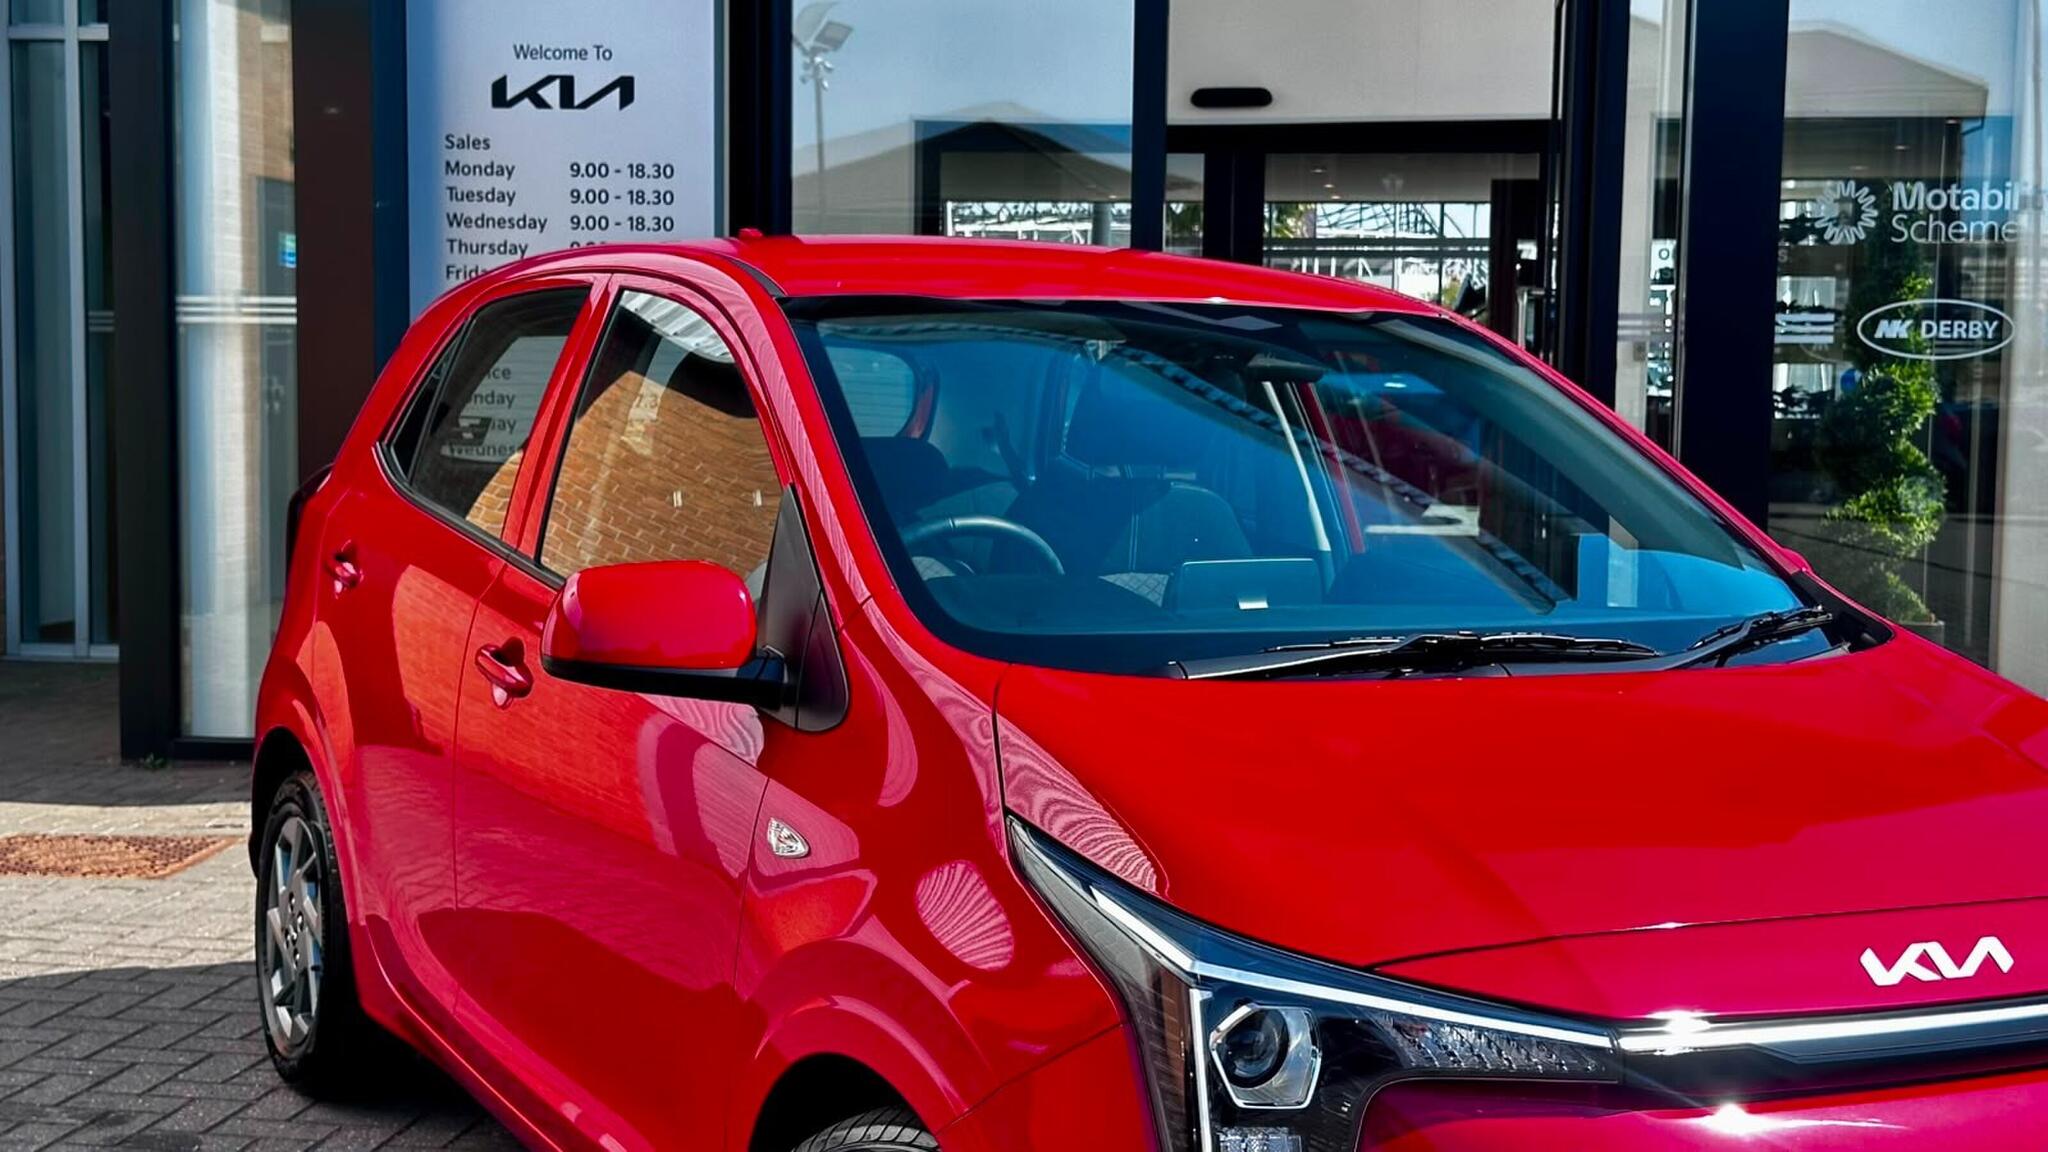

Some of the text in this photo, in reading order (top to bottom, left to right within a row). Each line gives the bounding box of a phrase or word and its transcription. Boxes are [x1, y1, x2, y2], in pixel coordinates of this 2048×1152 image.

[513, 44, 613, 60] Welcome To
[491, 74, 635, 110] KIA
[444, 133, 491, 150] Sales
[445, 160, 515, 180] Monday
[570, 163, 609, 178] 9.00
[628, 164, 674, 179] 18.30
[445, 186, 516, 206] Tuesday
[570, 189, 609, 204] 9.00
[628, 190, 674, 205] 18.30
[446, 212, 548, 231] Wednesday
[570, 215, 609, 231] 9.00
[628, 216, 674, 232] 18.30
[1891, 214, 2019, 243] Scheme
[446, 238, 528, 258] Thursday
[1920, 319, 1999, 339] DERBY
[1860, 936, 2014, 986] KIA
